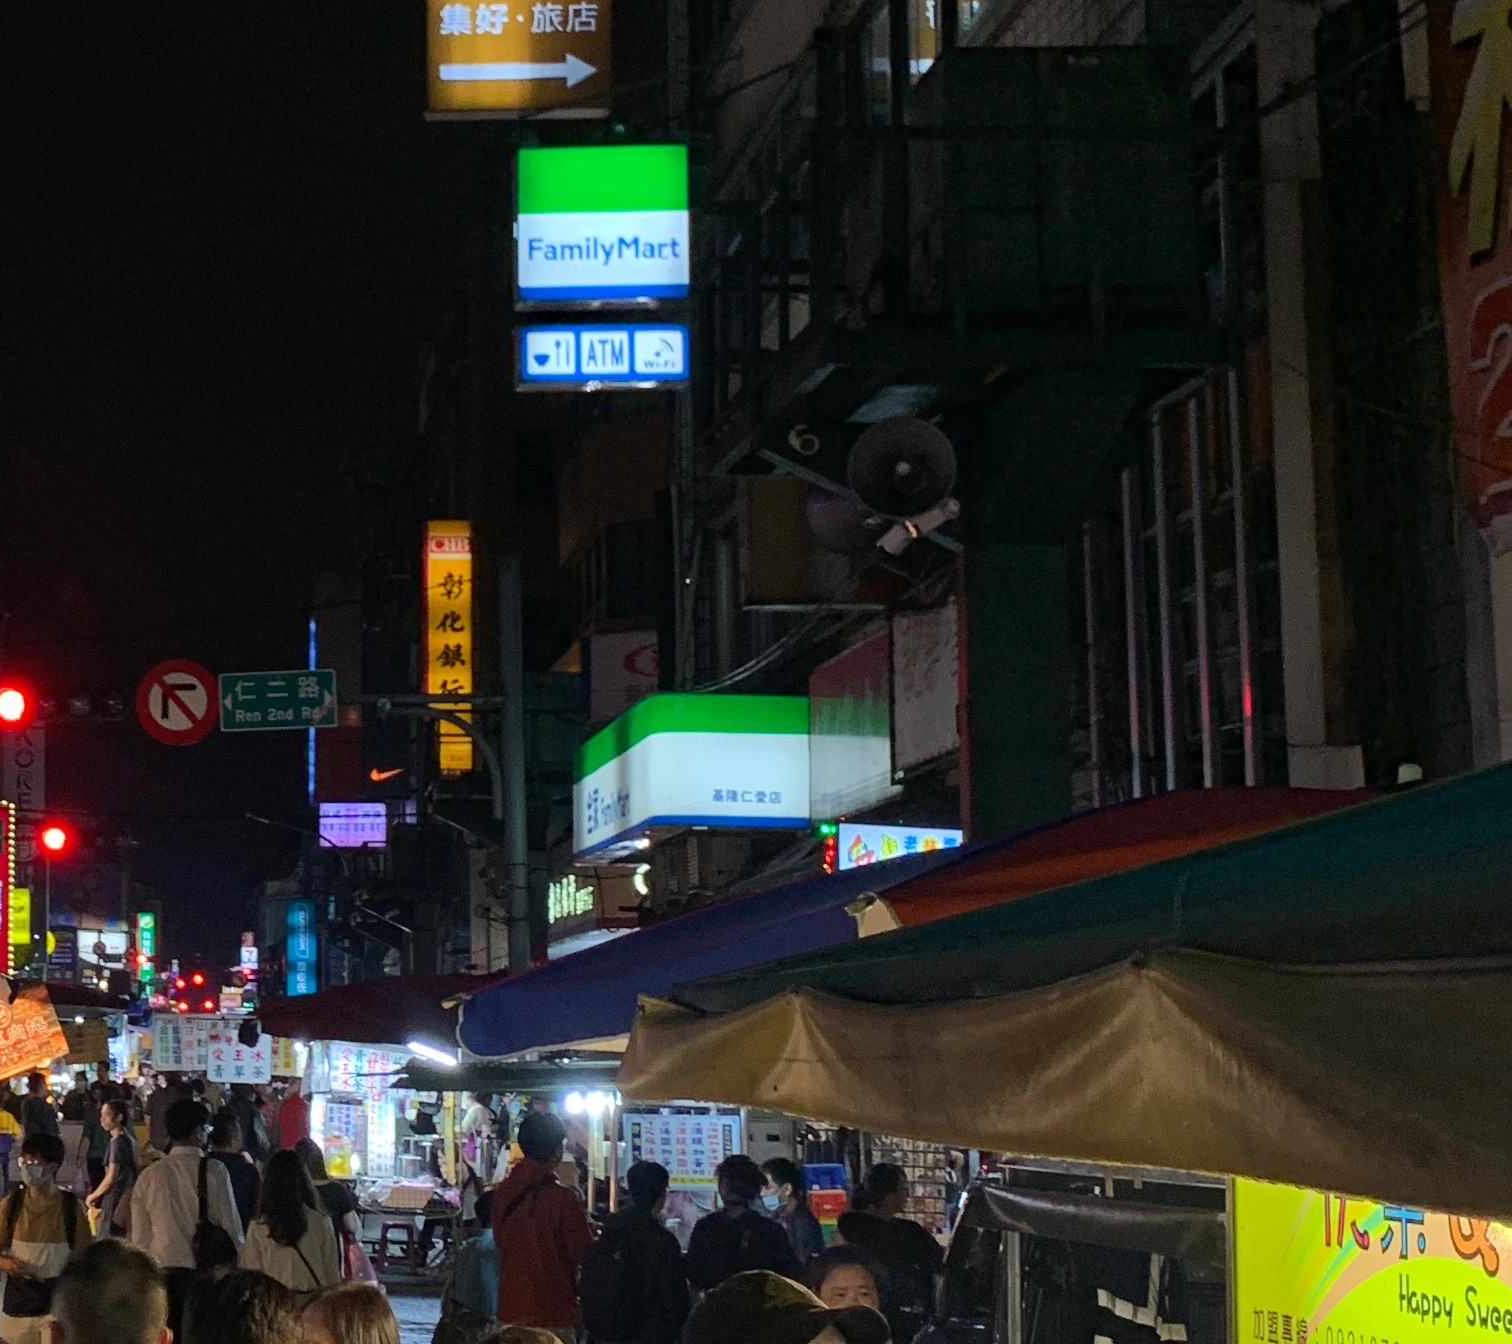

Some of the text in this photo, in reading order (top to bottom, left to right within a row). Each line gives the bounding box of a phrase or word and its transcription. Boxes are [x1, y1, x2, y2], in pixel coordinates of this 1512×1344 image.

[527, 237, 680, 266] FamilyMart
[586, 338, 625, 368] ATM
[643, 359, 676, 370] Wi-Fi
[235, 675, 321, 703] 仁二路
[235, 708, 262, 723] Ren
[267, 707, 294, 722] 2nd
[712, 788, 782, 805] 基隆仁愛店
[1398, 1272, 1455, 1330] Happy
